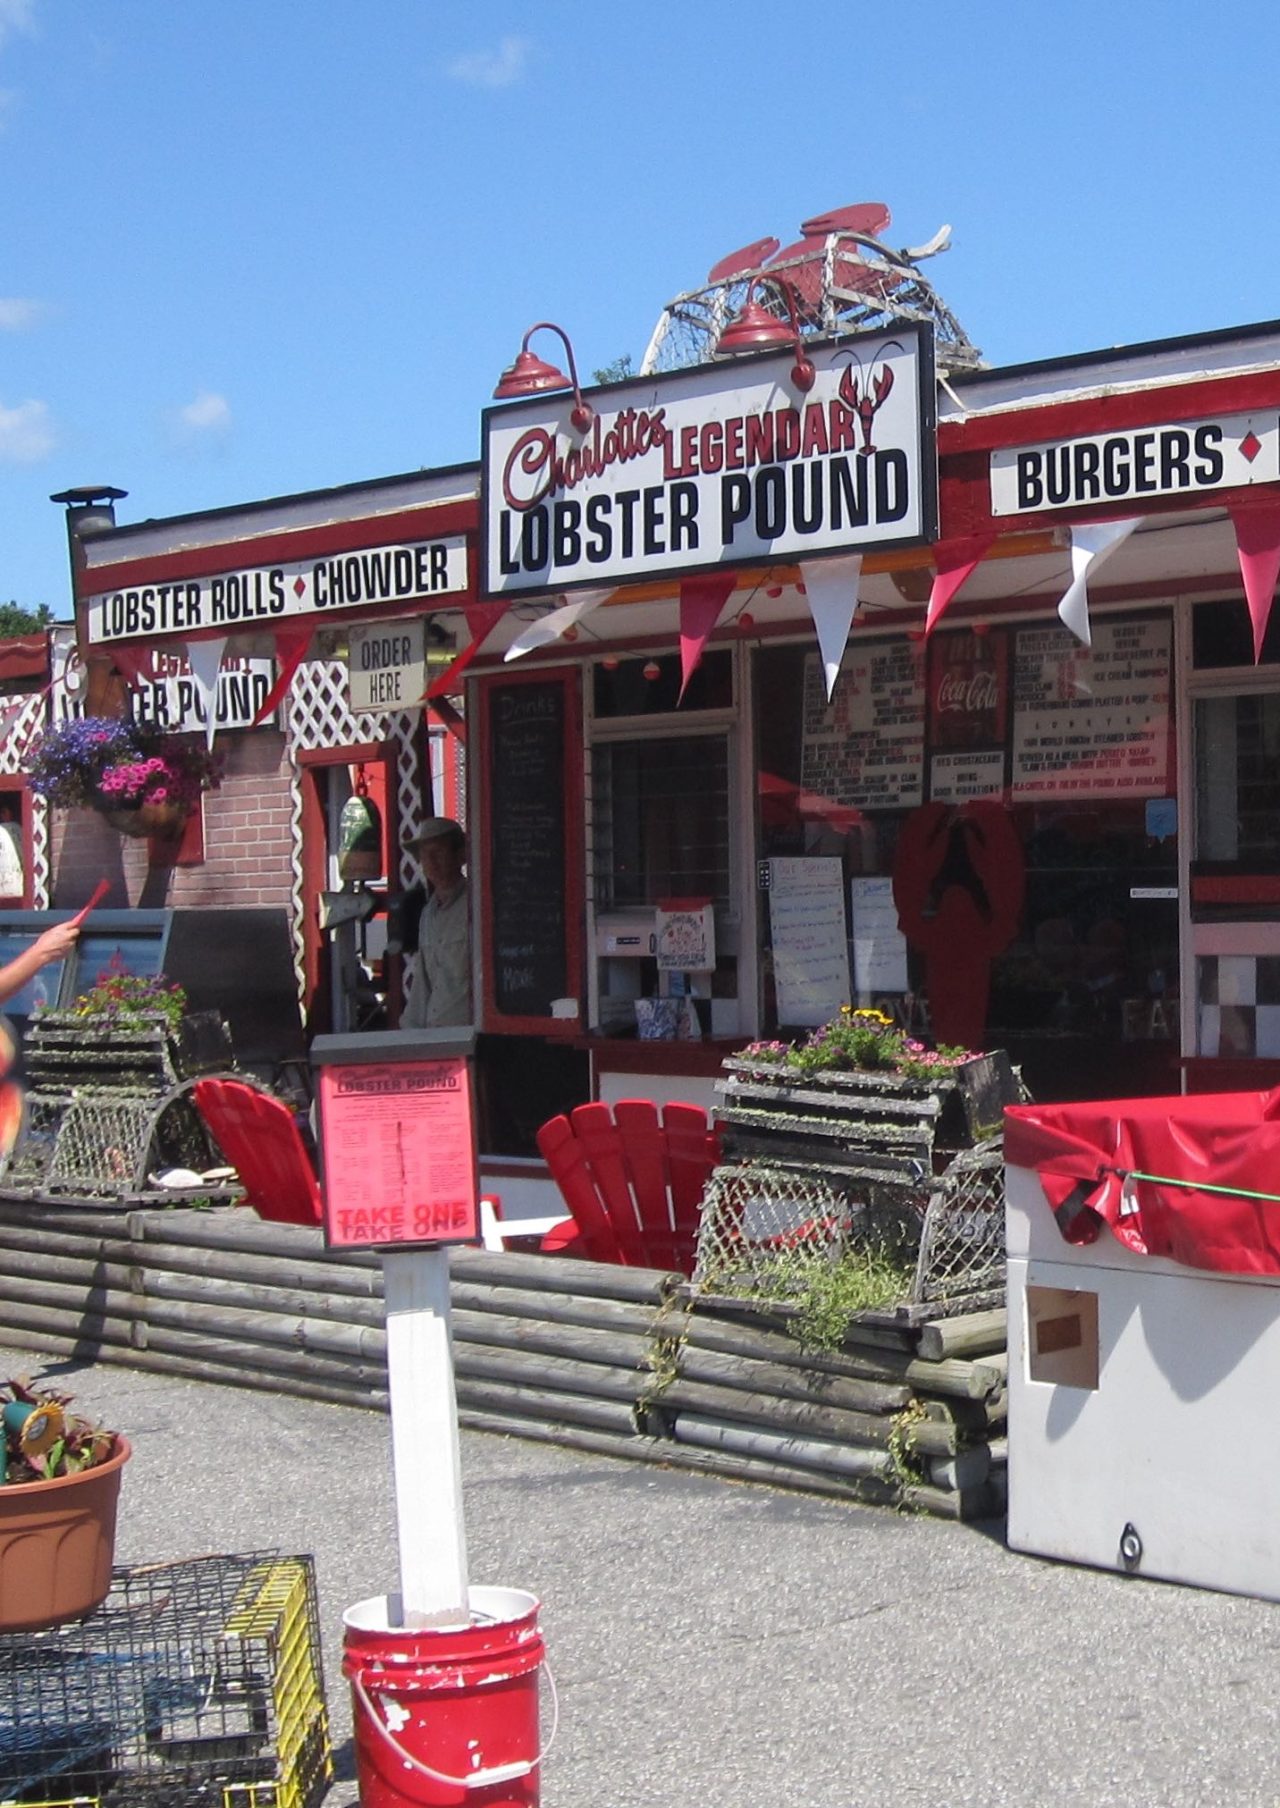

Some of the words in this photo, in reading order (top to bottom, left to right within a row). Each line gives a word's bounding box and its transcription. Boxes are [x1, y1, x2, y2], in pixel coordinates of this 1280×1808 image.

[1016, 424, 1225, 509] BURGERS
[499, 480, 699, 576] LOBSTER
[720, 448, 909, 545] POUND
[102, 579, 202, 638] LOBSTER
[211, 568, 285, 622] ROLLS
[313, 543, 449, 608] CHOWDER
[361, 636, 411, 671] ORDER
[370, 671, 402, 704] HERE
[337, 1079, 402, 1094] LOBSTER
[407, 1077, 457, 1089] POUND
[337, 1206, 404, 1226] TAKE
[414, 1201, 467, 1222] ONE
[340, 1225, 405, 1240] TAKE
